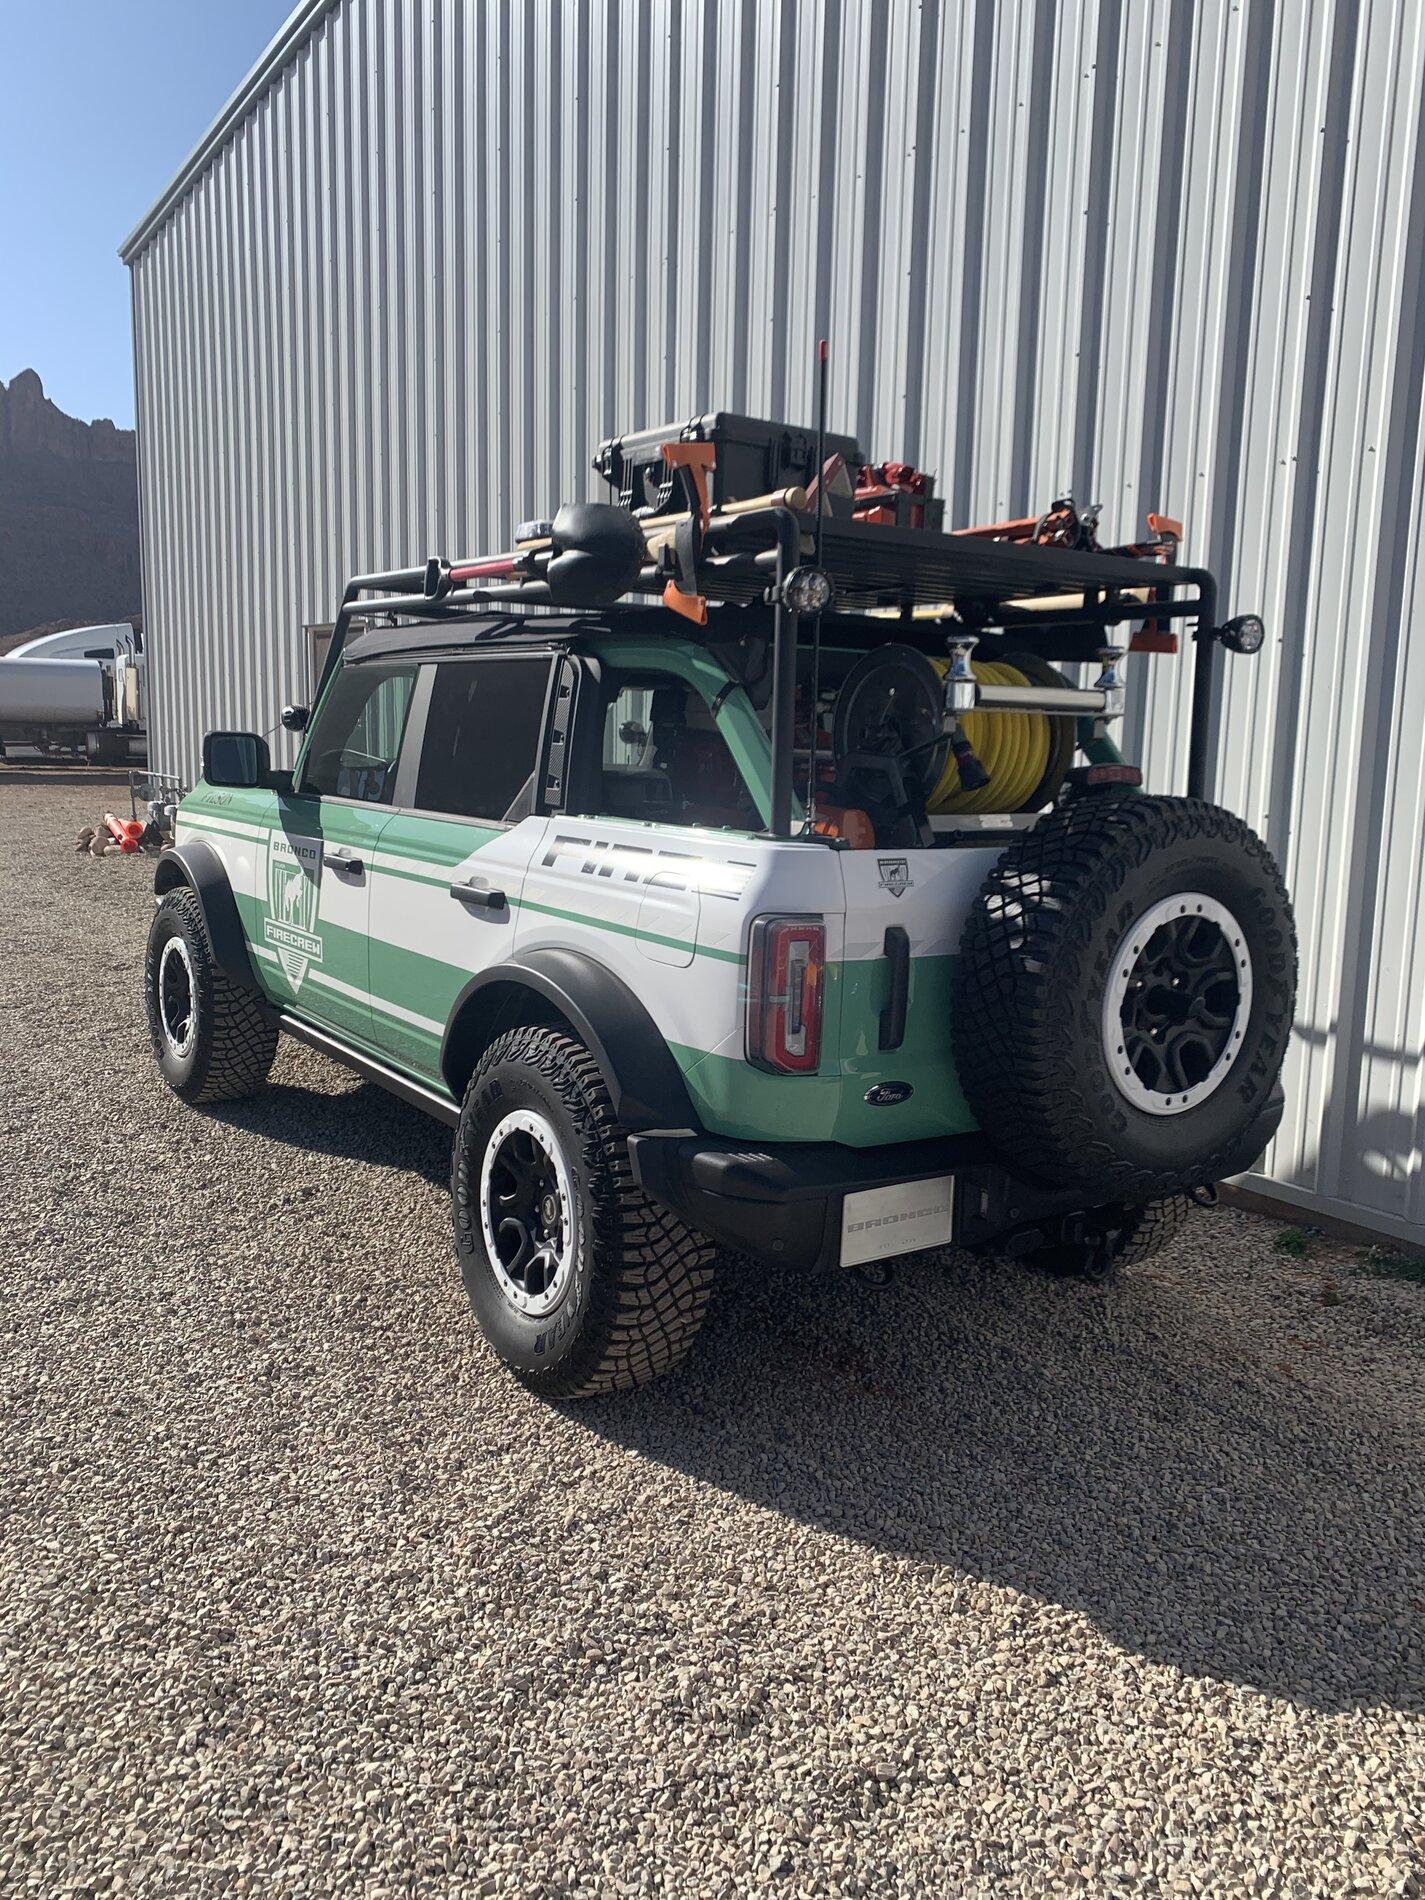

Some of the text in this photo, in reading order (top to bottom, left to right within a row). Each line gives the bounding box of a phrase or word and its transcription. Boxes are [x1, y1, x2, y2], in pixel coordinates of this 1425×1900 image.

[273, 841, 316, 860] BRONCO
[266, 925, 320, 955] FIRECREW
[847, 1205, 949, 1234] BRONCO
